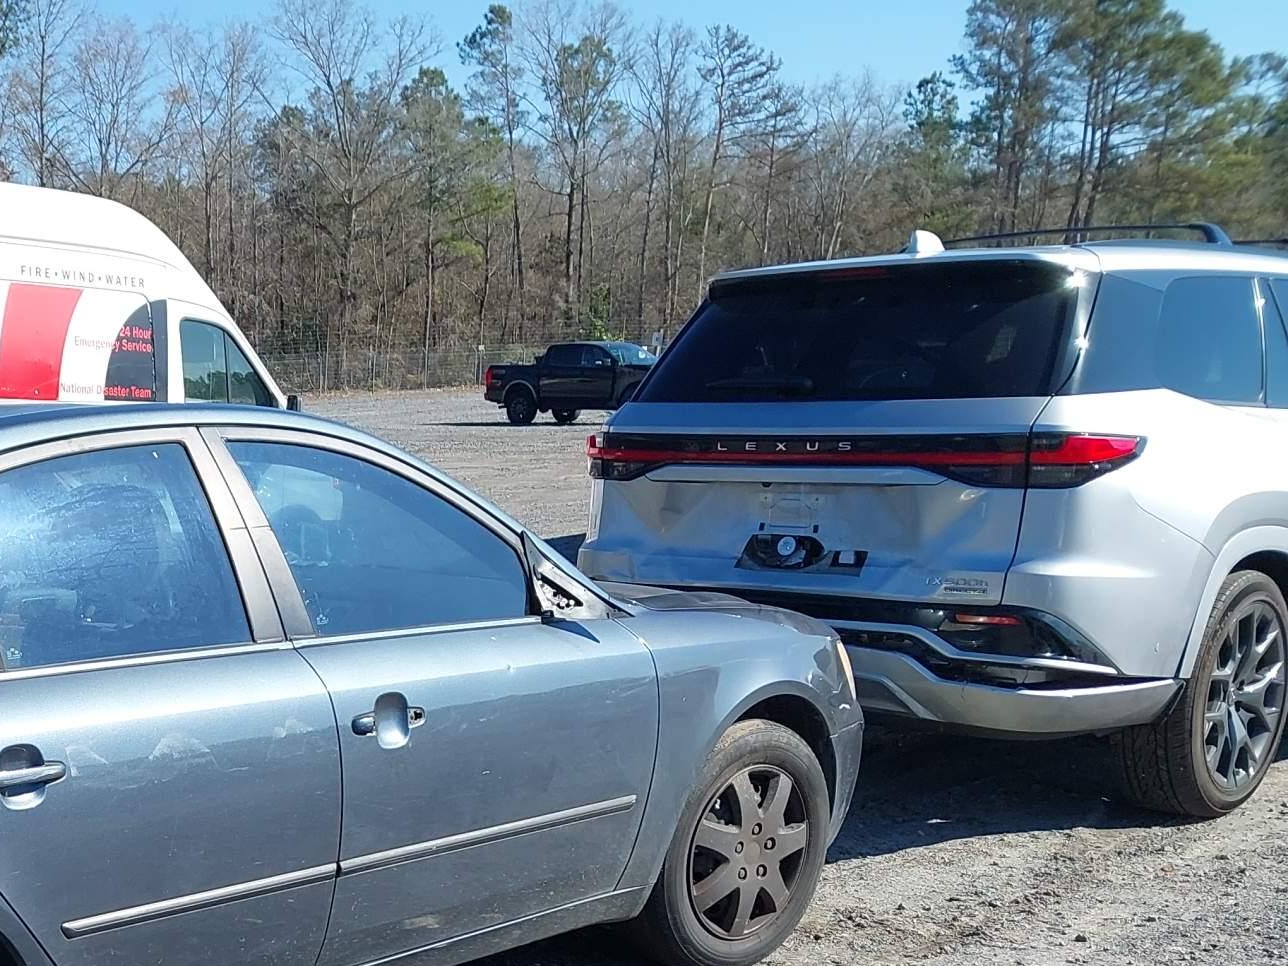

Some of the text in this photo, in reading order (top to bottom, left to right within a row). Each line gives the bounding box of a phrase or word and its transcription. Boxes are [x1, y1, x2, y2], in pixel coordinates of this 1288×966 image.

[20, 264, 146, 288] FIRE WIND WATER
[119, 325, 152, 339] 24 Hour
[59, 383, 94, 395] National
[130, 385, 152, 398] Team
[717, 441, 852, 451] LEXUS
